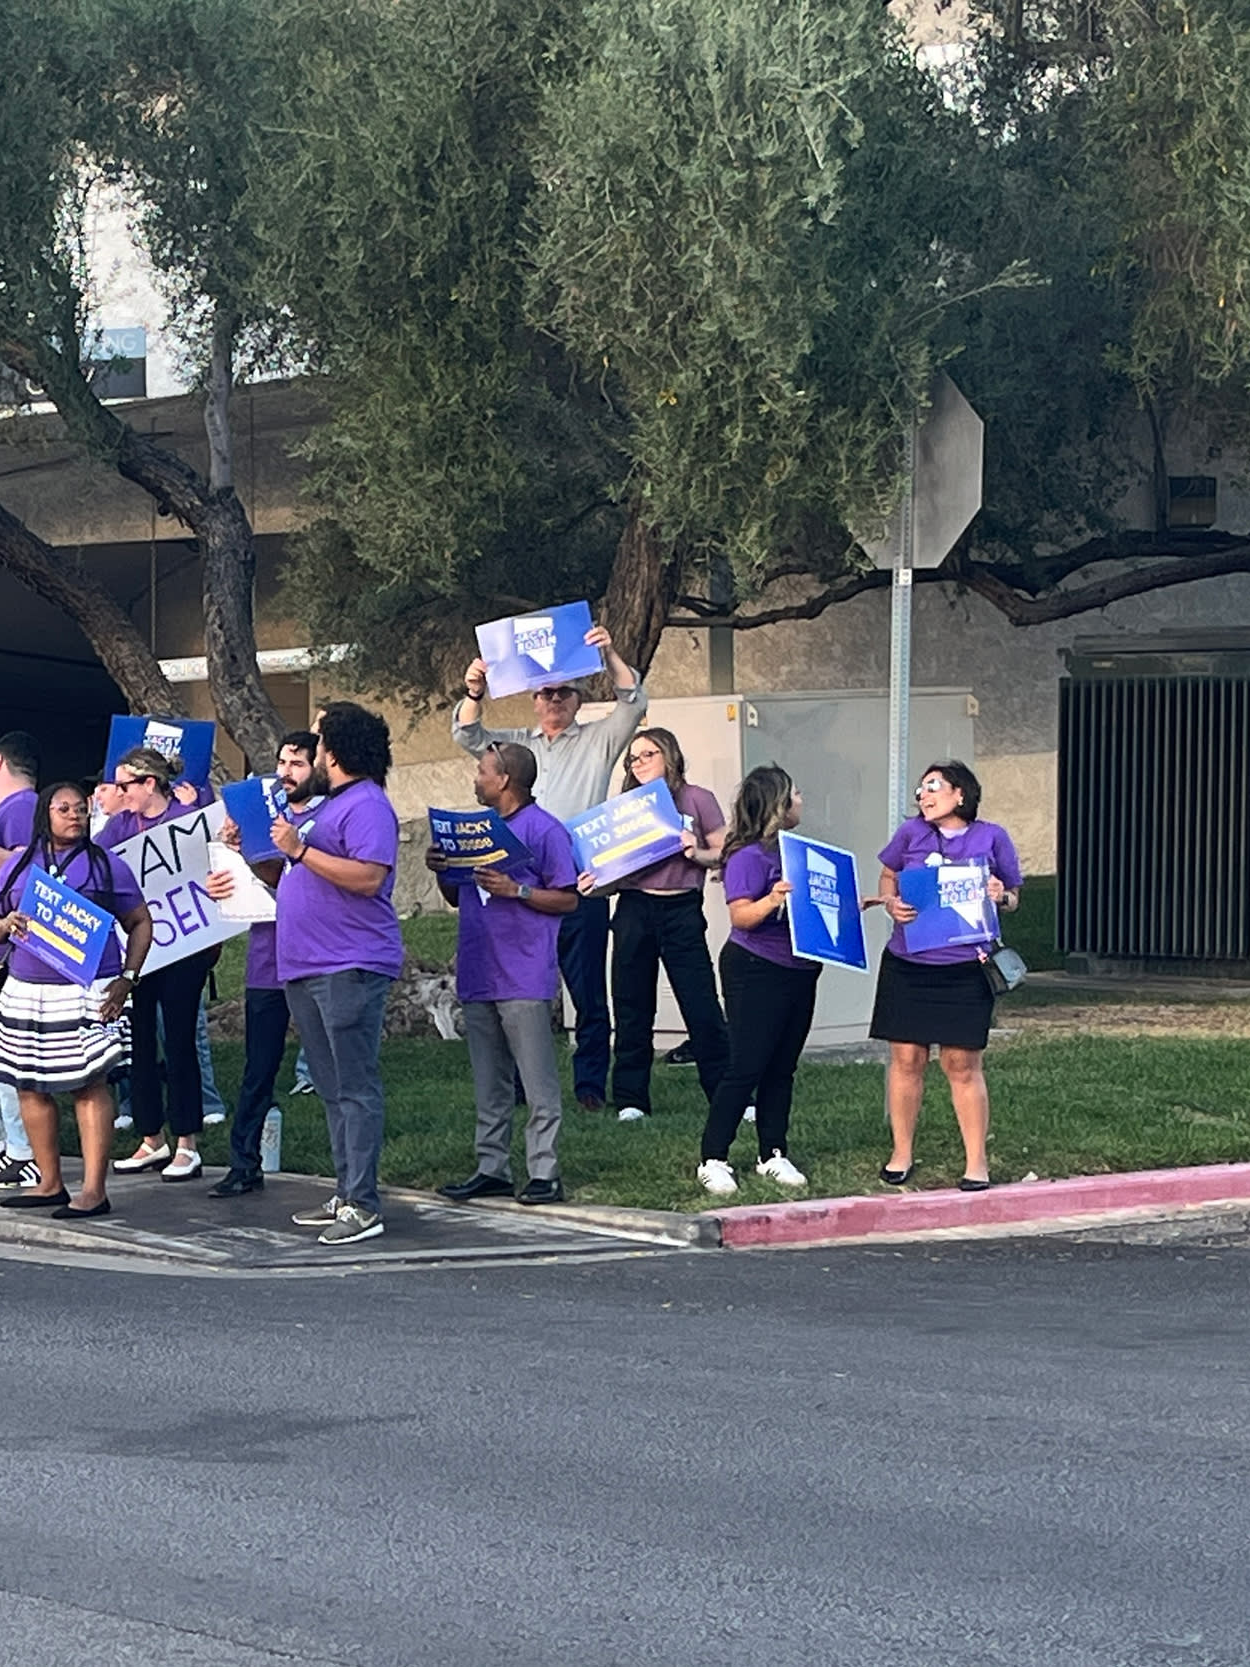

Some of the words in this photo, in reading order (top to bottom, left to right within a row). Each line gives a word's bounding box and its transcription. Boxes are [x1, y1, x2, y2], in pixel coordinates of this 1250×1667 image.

[573, 814, 608, 839] TEXT
[612, 791, 658, 821] JACKY
[432, 819, 452, 834] TEXT
[454, 819, 493, 835] JACKY
[117, 812, 212, 888] AM
[440, 838, 456, 851] TO
[588, 832, 610, 849] TO
[33, 879, 63, 906] TEXT
[61, 901, 103, 934] JACKY
[36, 901, 54, 922] TO
